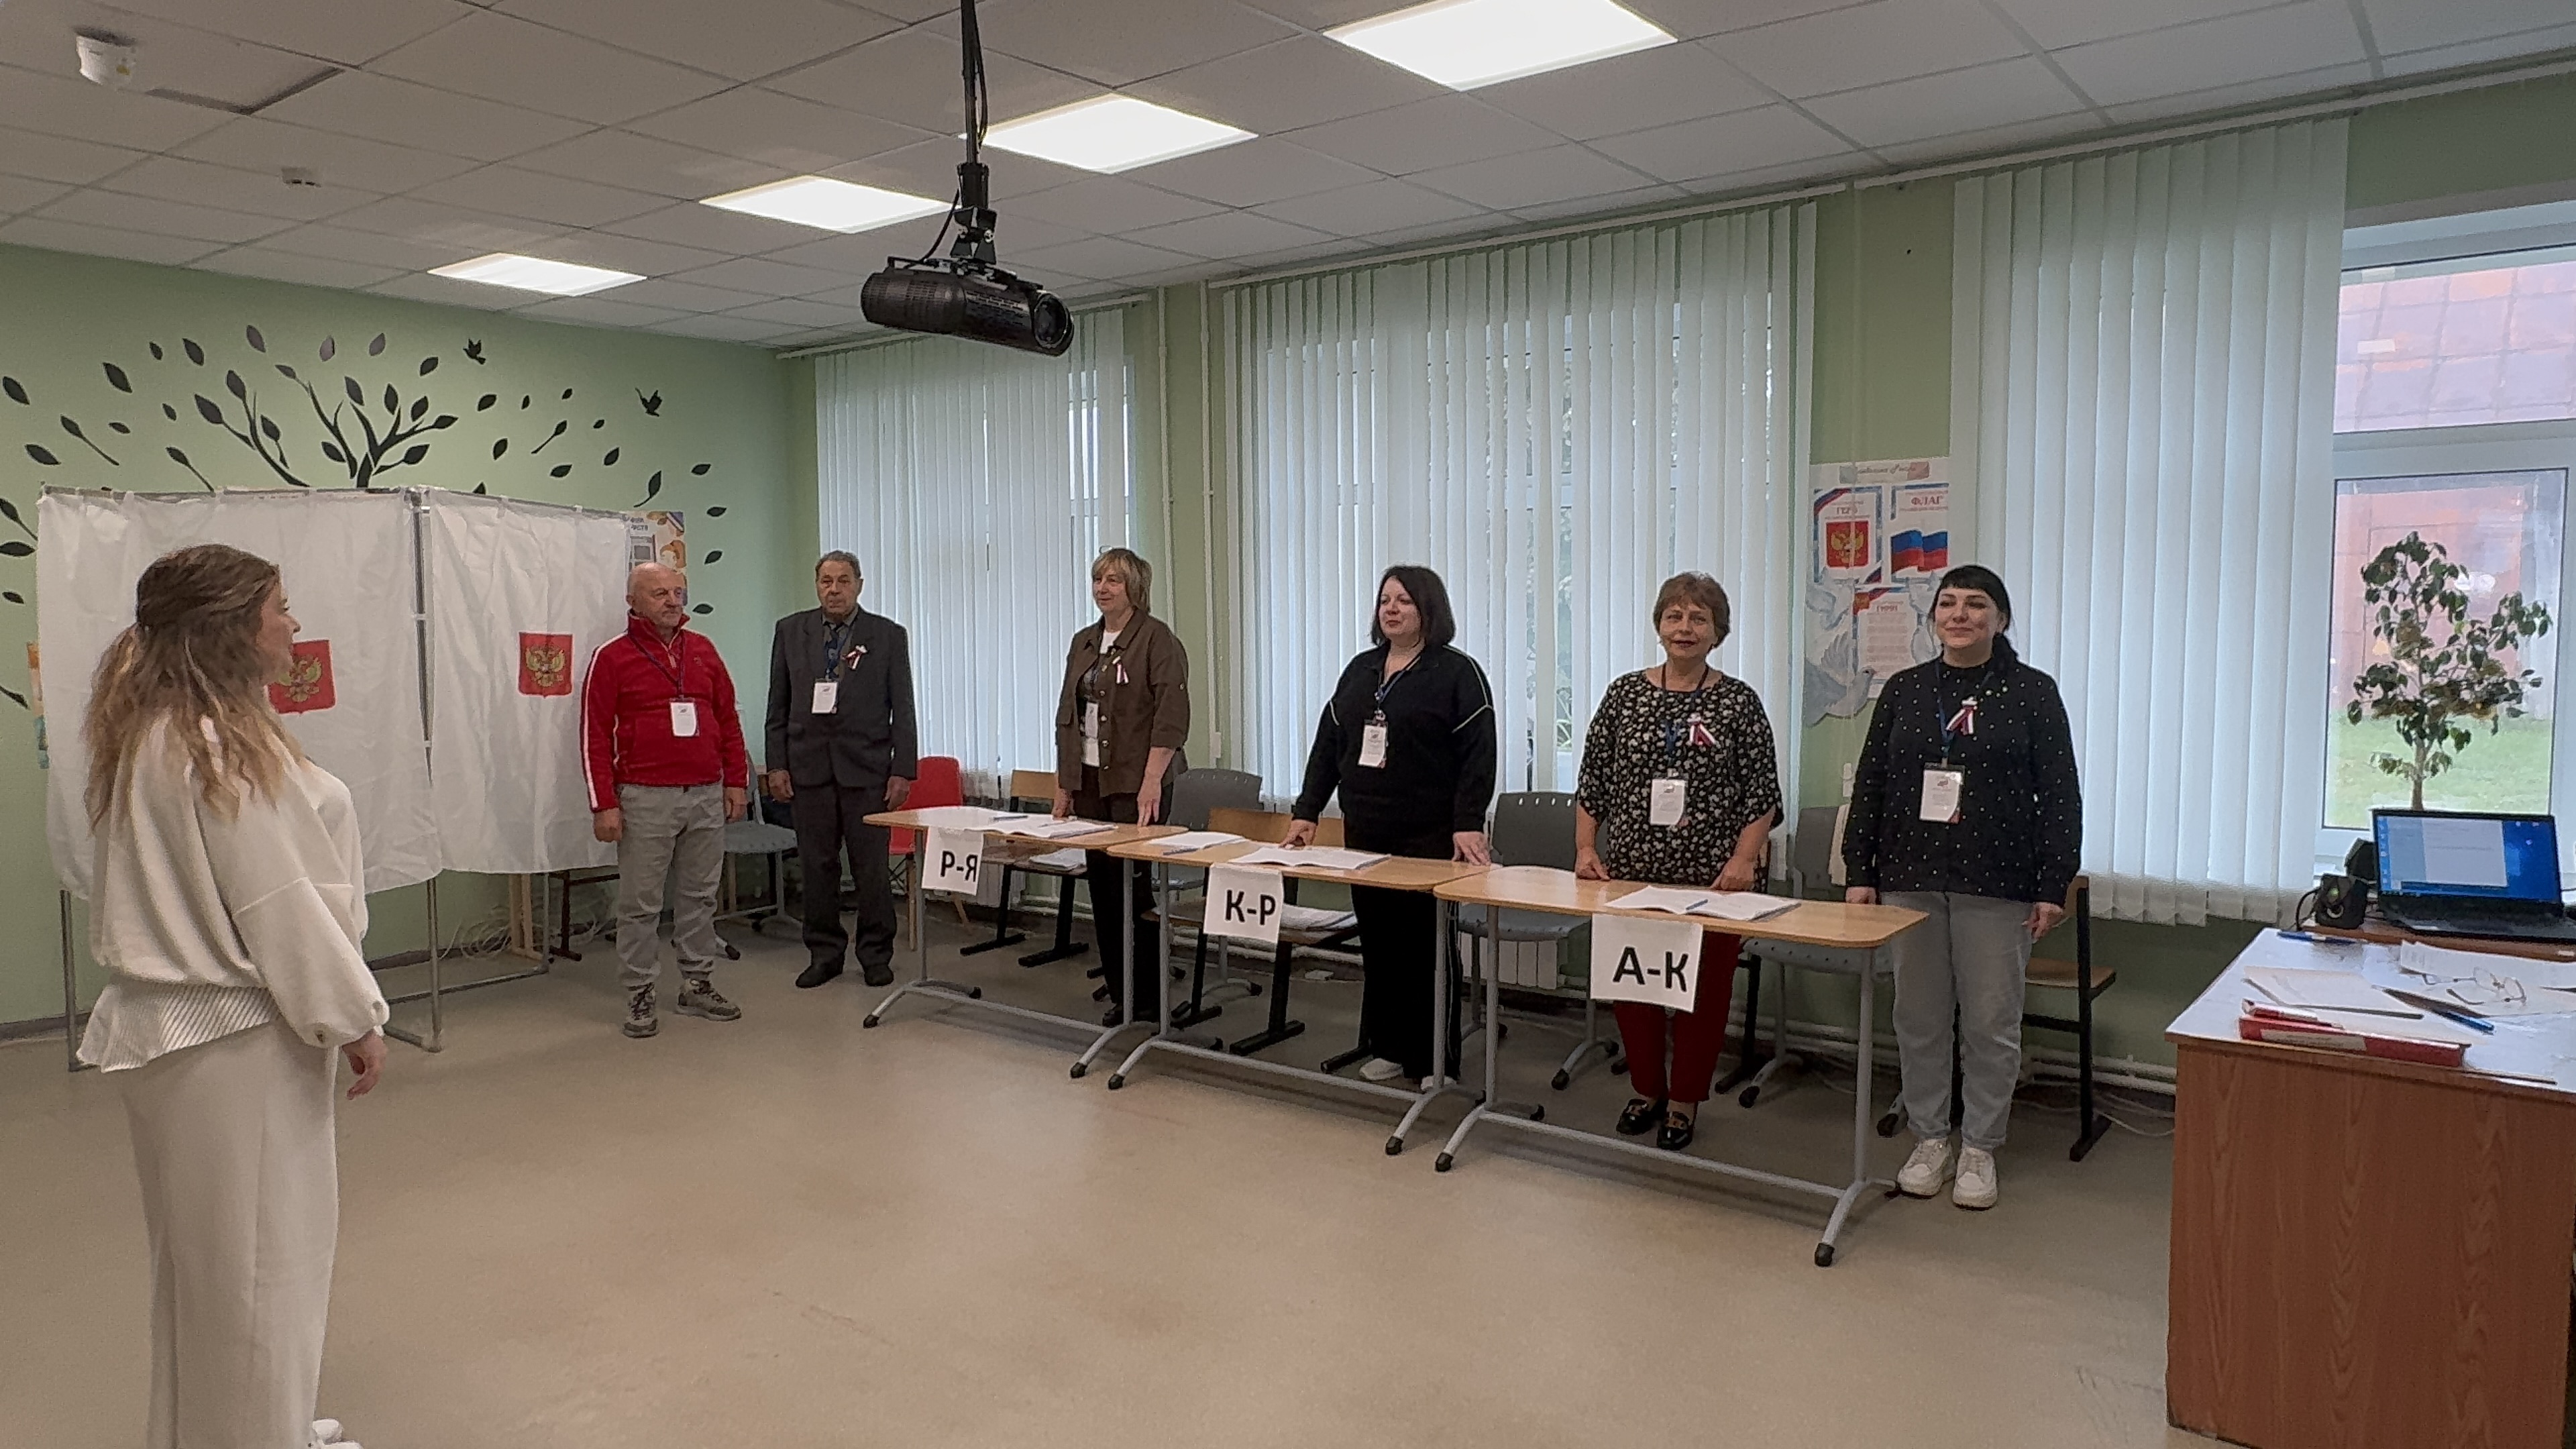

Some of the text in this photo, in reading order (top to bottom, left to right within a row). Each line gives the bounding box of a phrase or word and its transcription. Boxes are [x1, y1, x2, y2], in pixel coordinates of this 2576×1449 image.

[1911, 495, 1943, 506] ФЛАГ
[940, 850, 978, 882] Р-Я
[1225, 890, 1276, 926] К-Р
[1613, 947, 1688, 992] А-К
